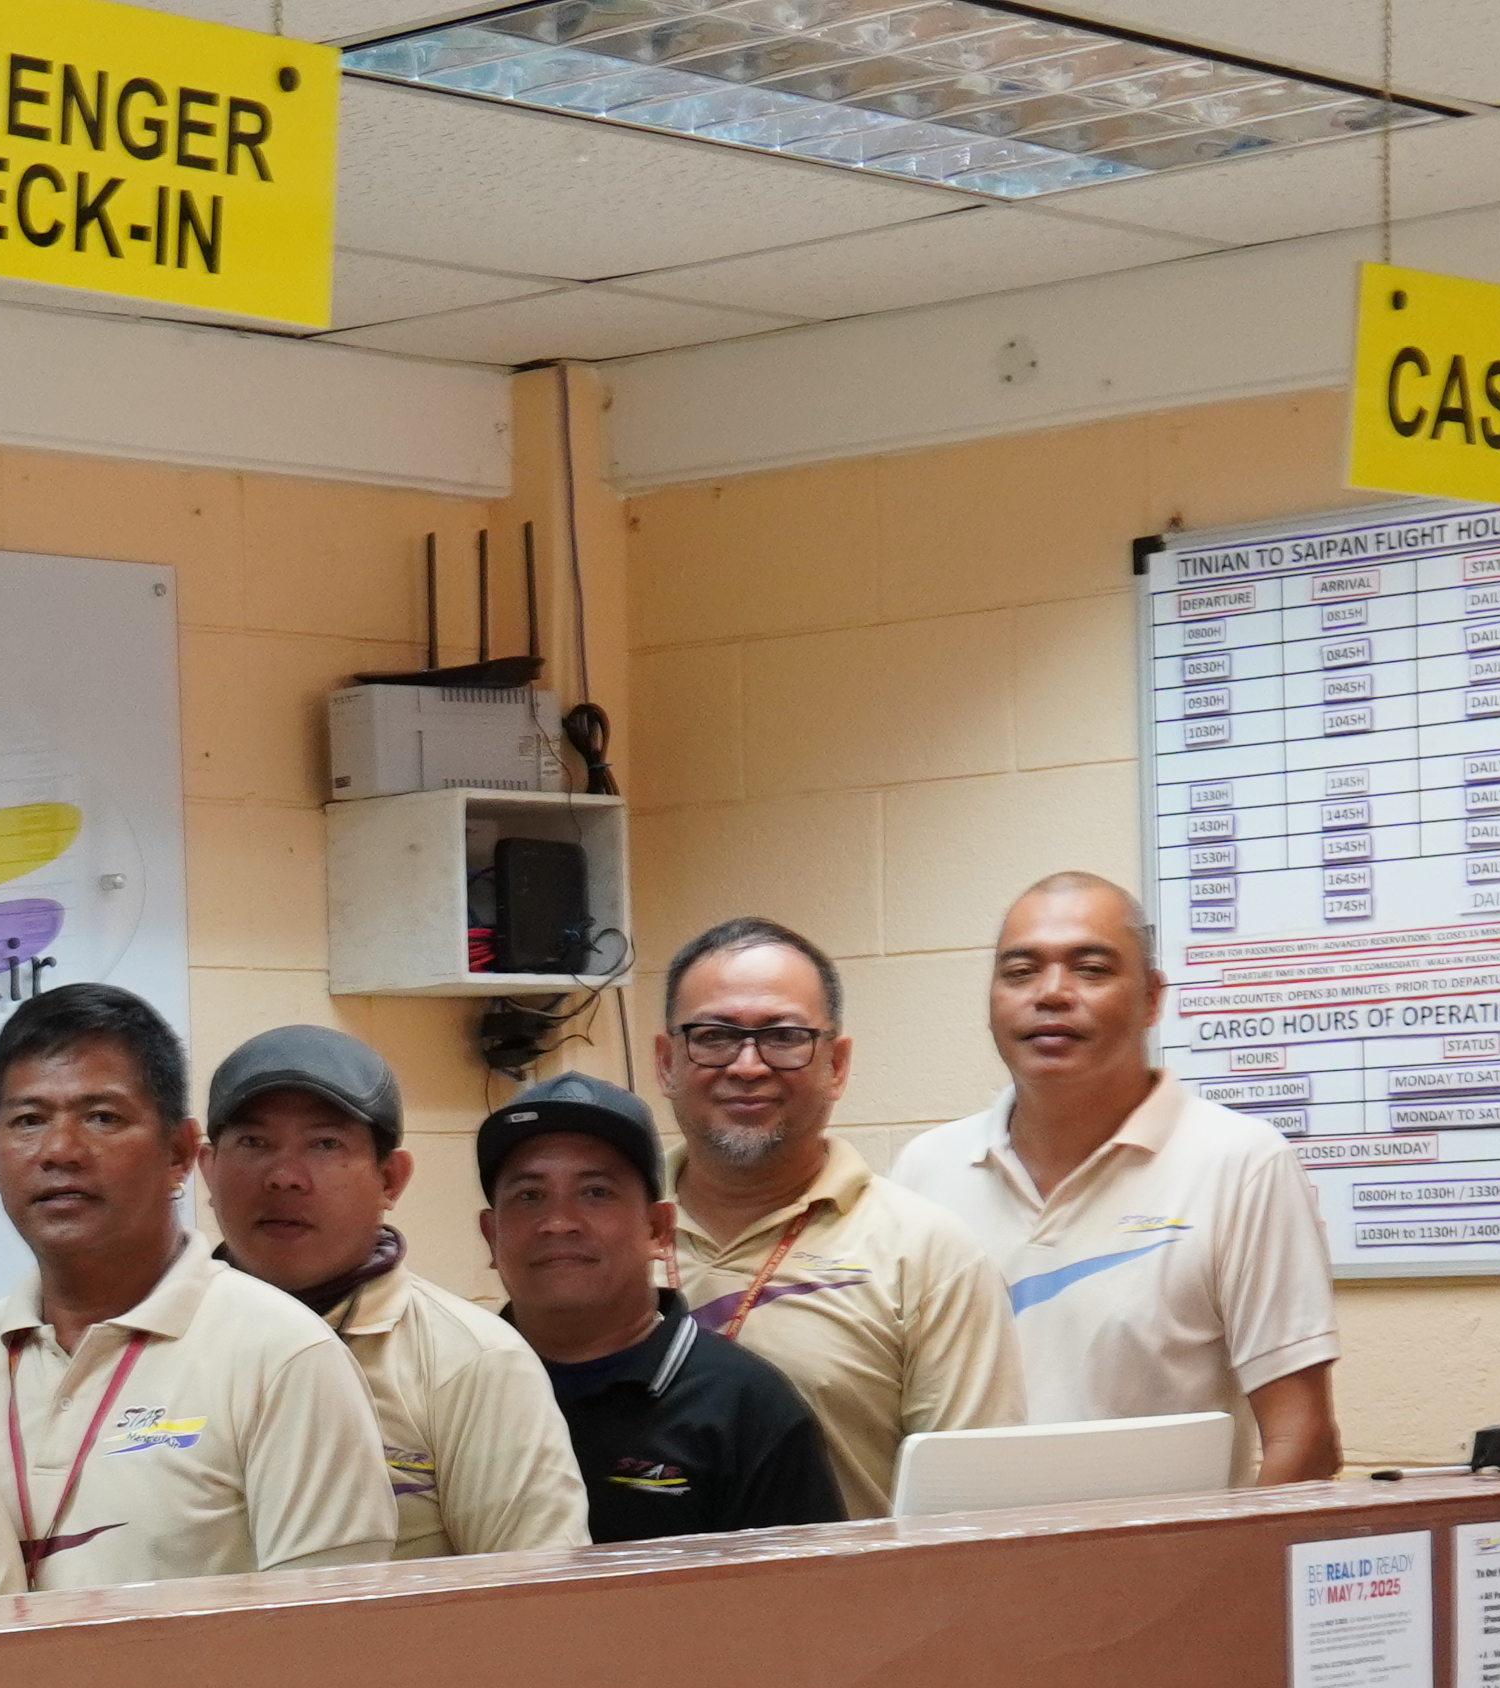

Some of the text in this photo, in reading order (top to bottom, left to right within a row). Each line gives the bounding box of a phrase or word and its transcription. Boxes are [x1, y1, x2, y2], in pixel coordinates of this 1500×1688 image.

[1179, 551, 1251, 578] TINIAN
[1256, 547, 1284, 569] TO
[1291, 536, 1368, 563] SAIPAN
[1374, 523, 1450, 553] FLIGHT
[1320, 576, 1373, 593] ARRIVAL
[1182, 592, 1253, 612] DEPARTURE
[1187, 626, 1221, 640] 0800H
[1326, 645, 1366, 662] 0845H
[1187, 660, 1225, 675] 0830H
[1327, 680, 1367, 696] 0945H
[1187, 694, 1225, 710] 0930H
[1328, 713, 1367, 729] 1045H
[1188, 723, 1225, 739] 1030H
[1329, 774, 1366, 790] 1345H
[1196, 788, 1229, 803] 1330H
[1325, 807, 1365, 822] 1445H
[1192, 819, 1229, 834] 1430H
[1327, 838, 1367, 854] 1545H
[1194, 850, 1231, 865] 1530H
[1328, 871, 1367, 887] 1645H
[1194, 881, 1231, 896] 1630H
[1328, 899, 1367, 914] 1745H
[1195, 910, 1232, 924] 1730H
[1198, 1016, 1276, 1042] CARGO
[1282, 1009, 1360, 1035] HOURS
[1366, 1005, 1397, 1028] OF
[1446, 1037, 1496, 1053] STATUS
[1236, 1050, 1280, 1066] HOURS
[1394, 1073, 1455, 1089] MONDAY
[1457, 1072, 1474, 1085] TO
[1205, 1082, 1305, 1101] 0800H TO 1100H
[1396, 1108, 1455, 1123] MONDAY
[1457, 1107, 1475, 1120] TO
[1297, 1141, 1432, 1160] CLOSED ON SUNDAY
[1358, 1187, 1397, 1202] 0800H
[1399, 1188, 1413, 1200] to
[1416, 1185, 1456, 1200] 1030H
[1360, 1226, 1400, 1240] 1030H
[1402, 1226, 1416, 1239] to
[1419, 1224, 1459, 1238] 1130H
[1308, 1553, 1415, 1583] BE REAL ID READY
[1308, 1578, 1402, 1607] BY MAY 7, 2025
